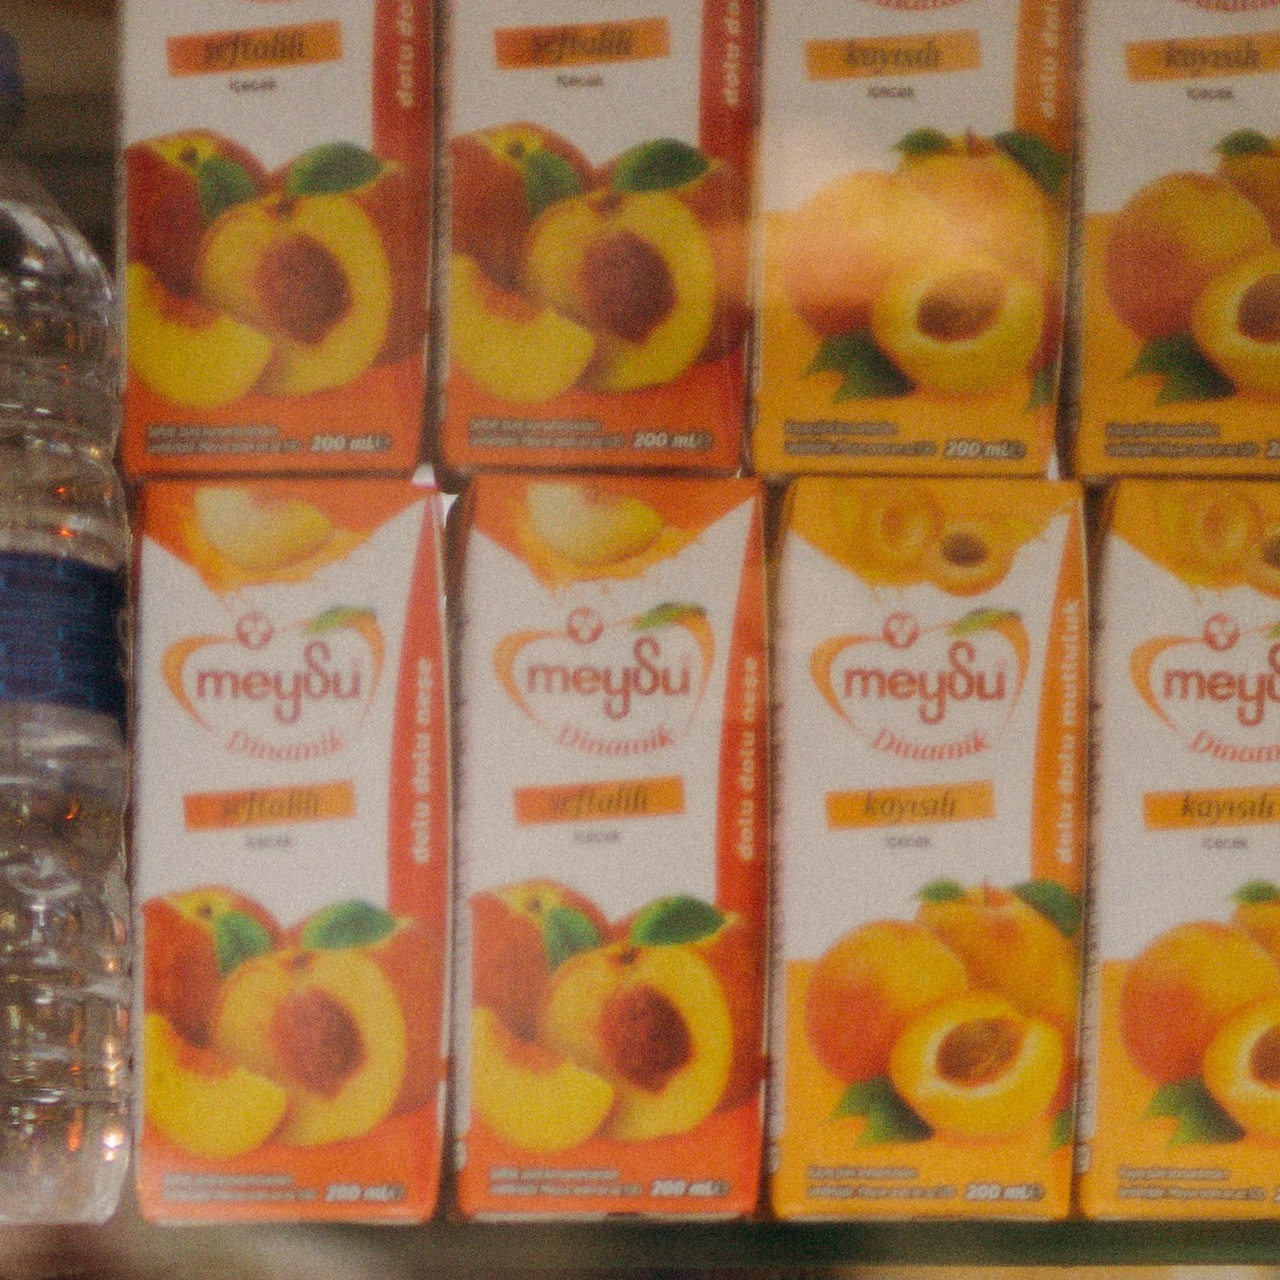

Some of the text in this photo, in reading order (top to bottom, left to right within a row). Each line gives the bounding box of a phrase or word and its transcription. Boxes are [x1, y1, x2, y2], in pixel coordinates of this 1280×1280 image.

[310, 433, 347, 454] 200
[632, 431, 669, 450] 200
[945, 440, 980, 458] 200
[224, 727, 346, 762] Dinamik
[556, 723, 676, 758] Dinamik
[872, 727, 990, 762] Dinamik
[739, 730, 756, 793] dolu
[737, 799, 755, 864] dolu
[325, 1183, 362, 1202] 200
[650, 1179, 687, 1198] 200
[965, 1183, 1000, 1201] 200
